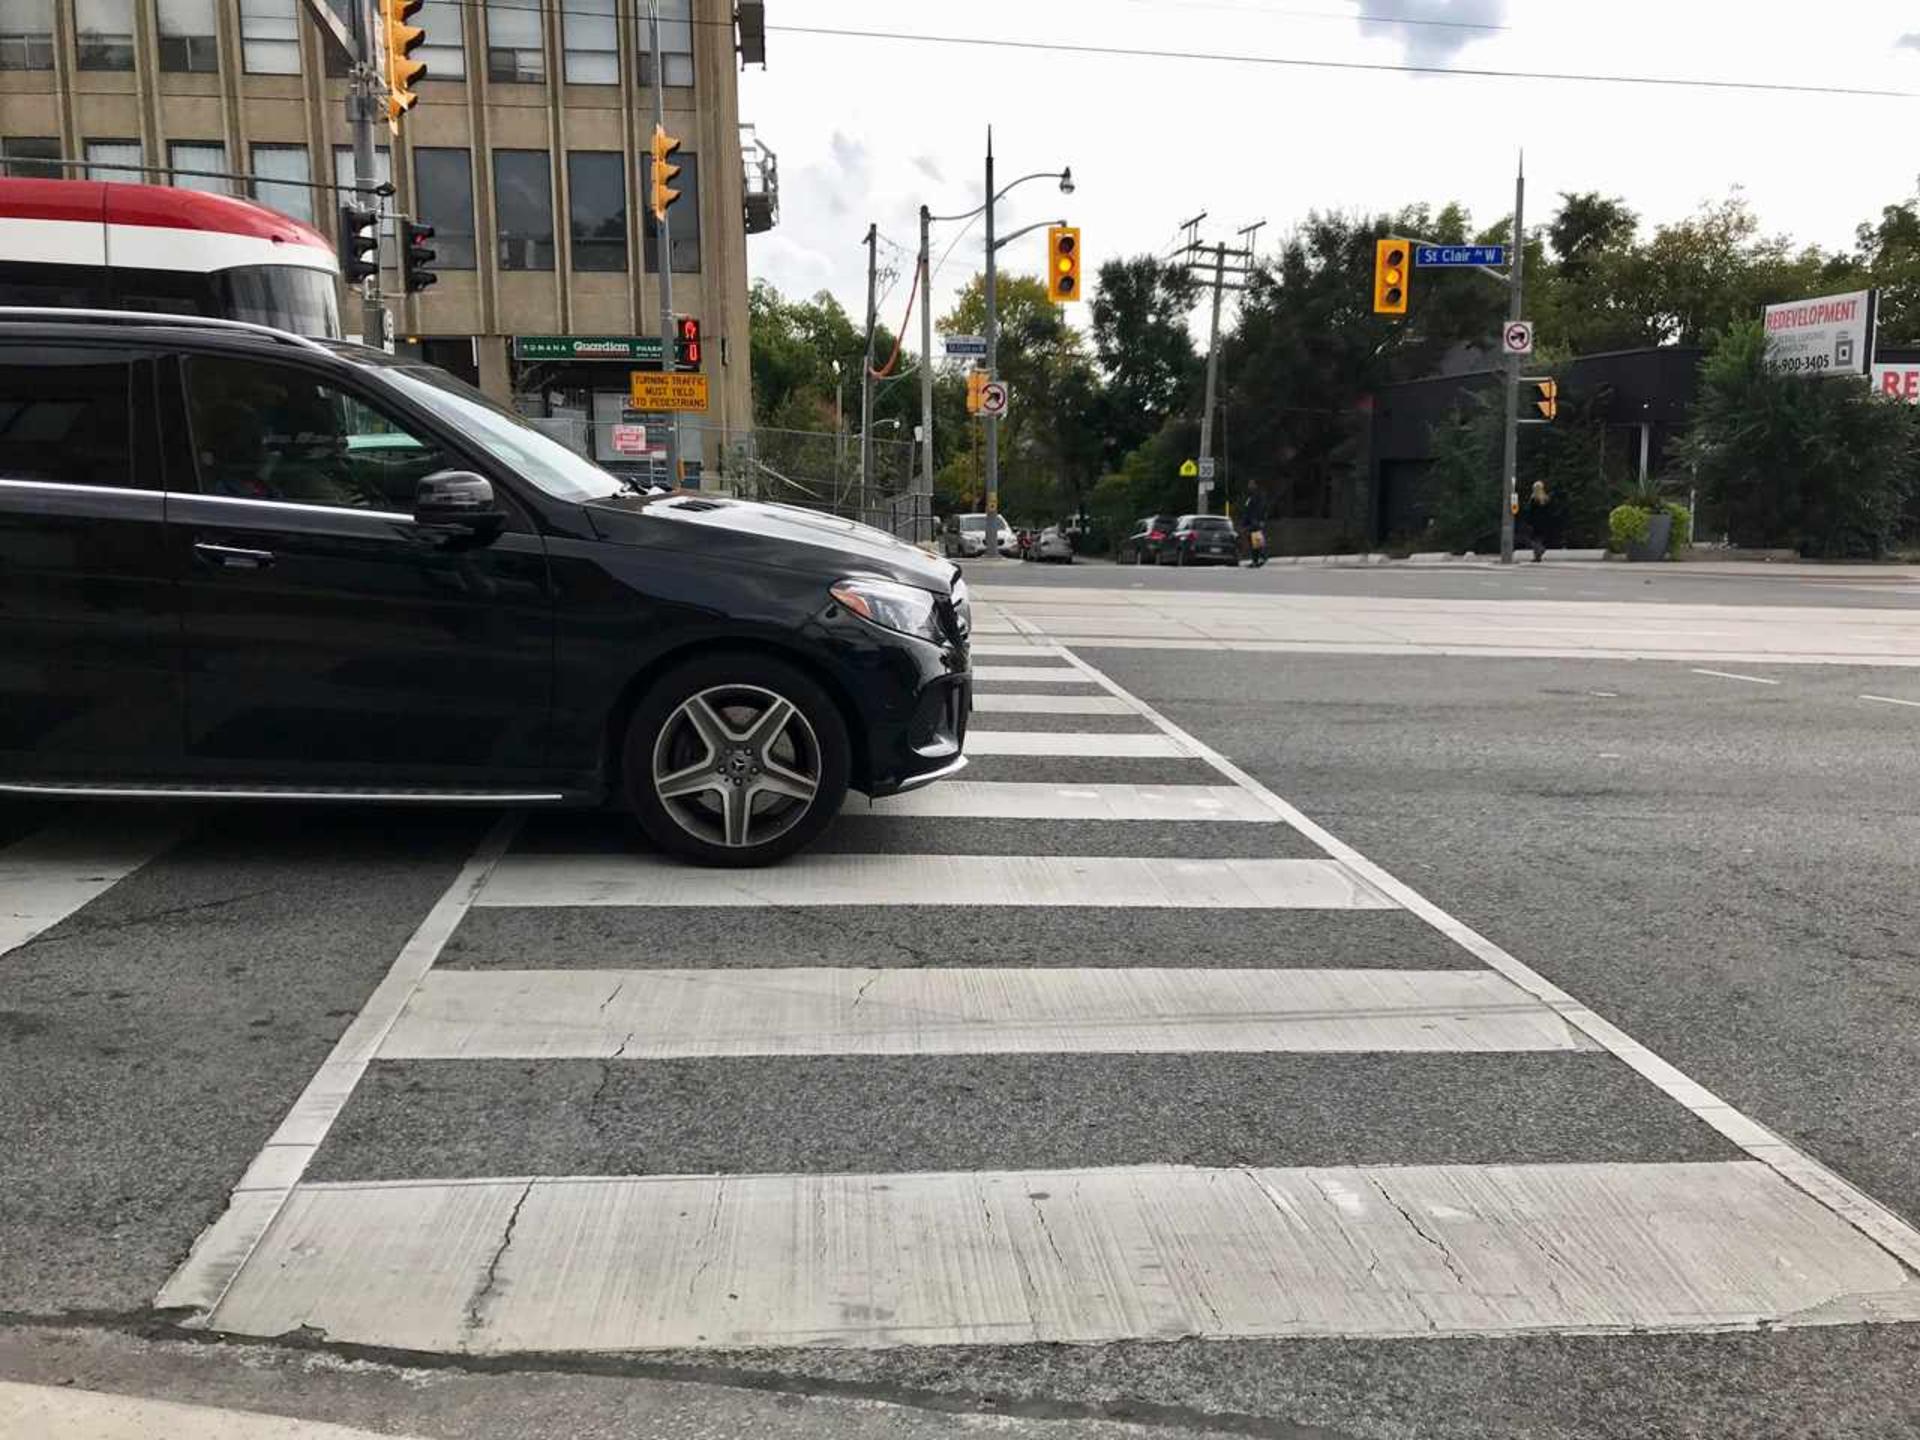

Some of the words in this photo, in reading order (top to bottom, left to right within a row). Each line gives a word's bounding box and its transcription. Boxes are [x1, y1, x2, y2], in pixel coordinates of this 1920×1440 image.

[1425, 249, 1437, 262] St
[1442, 248, 1471, 262] Clair
[1484, 248, 1496, 261] W
[1767, 301, 1857, 330] REDEVELOPMENT
[573, 341, 630, 351] Guardian
[635, 375, 669, 385] TURNING
[671, 376, 704, 386] TRAFFIC
[645, 387, 667, 396] MUST
[672, 388, 695, 397] YIELD
[635, 397, 647, 407] TO
[649, 398, 704, 408] PEDESTRIANS
